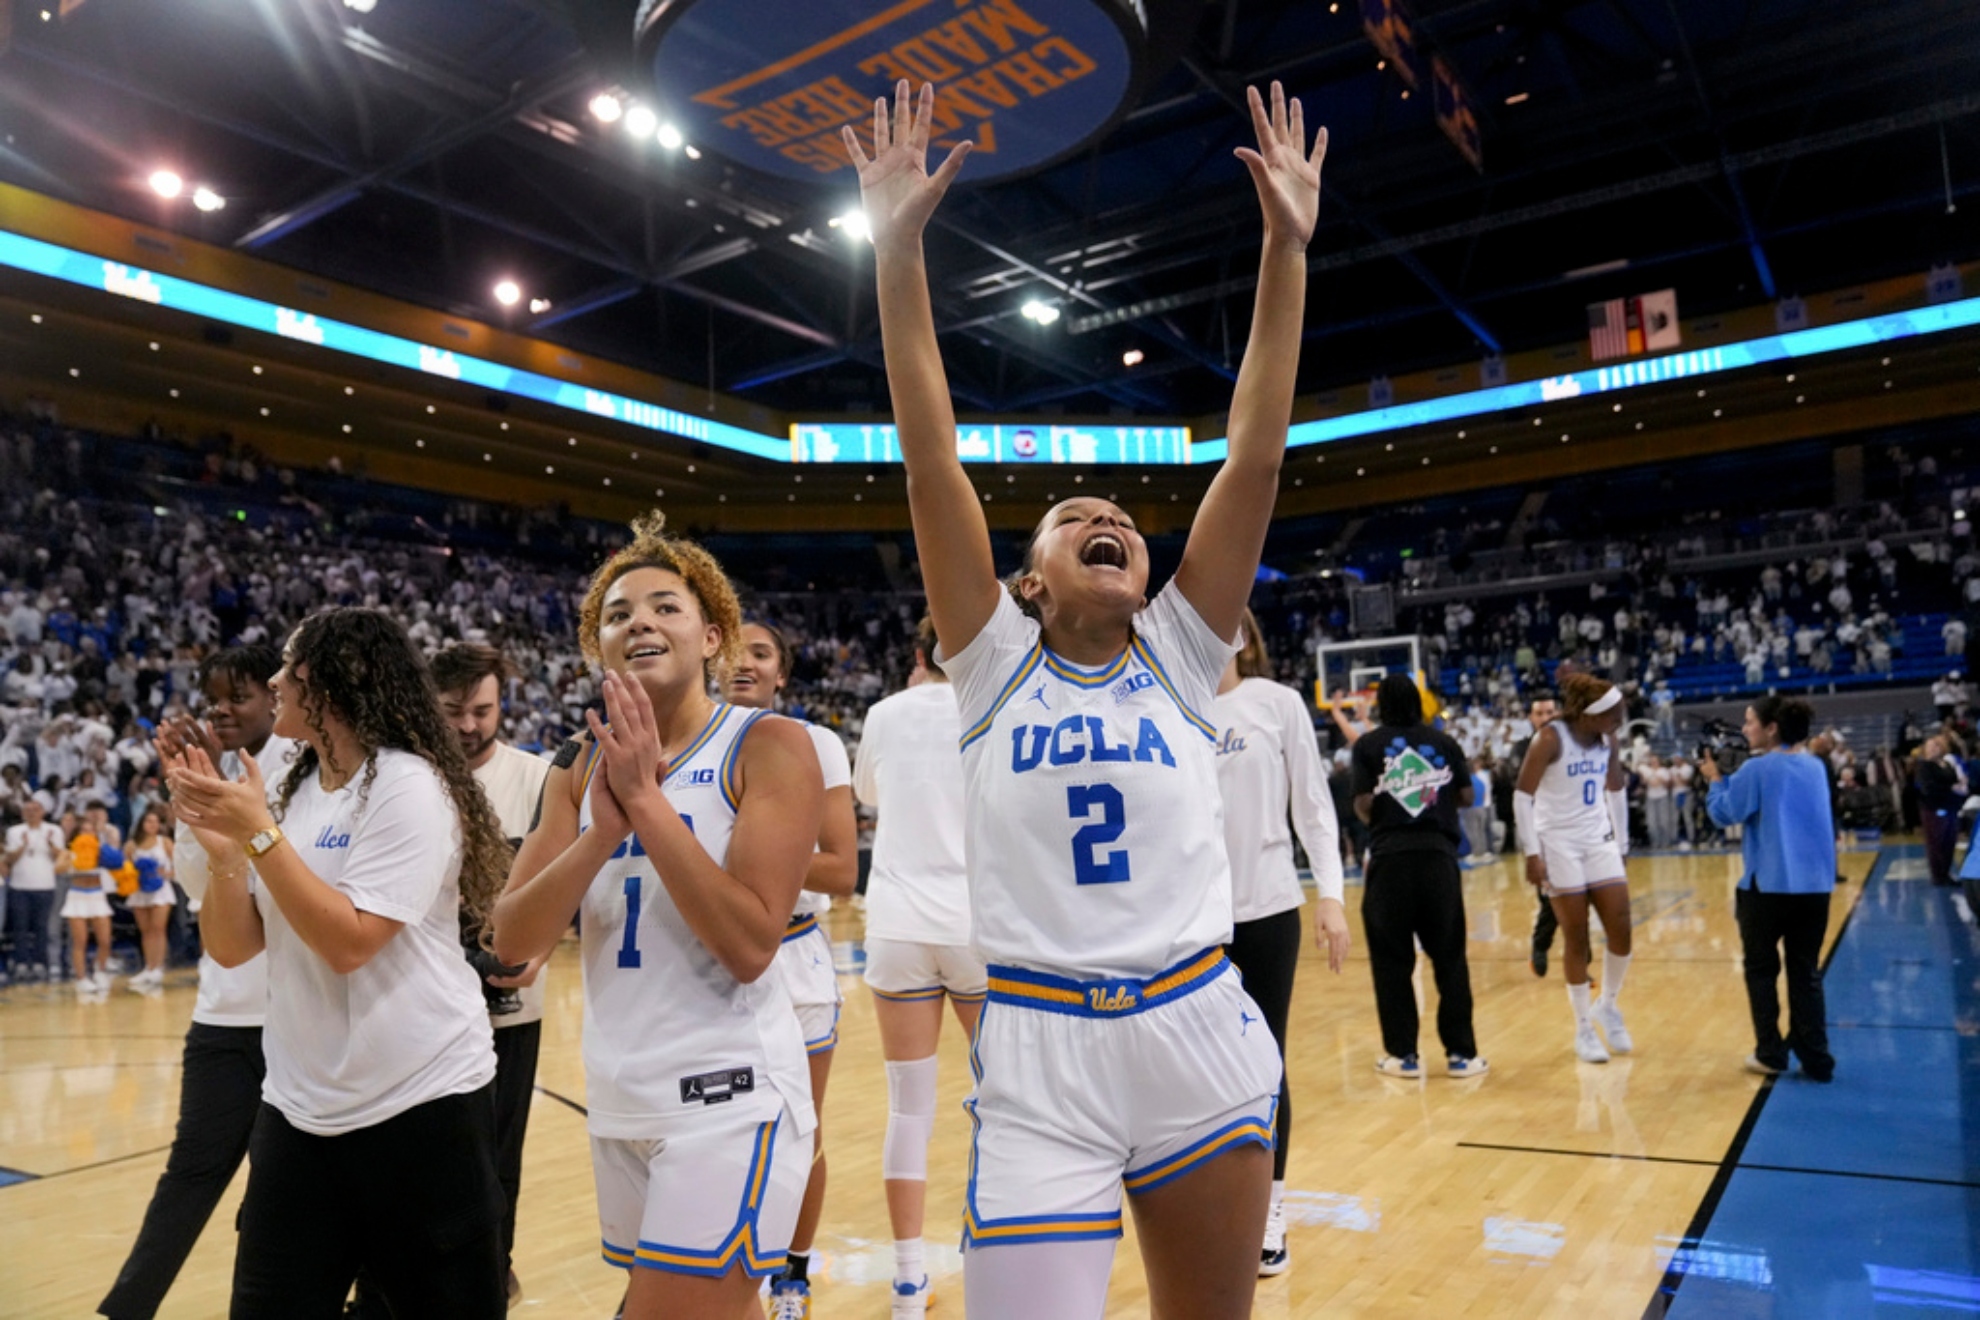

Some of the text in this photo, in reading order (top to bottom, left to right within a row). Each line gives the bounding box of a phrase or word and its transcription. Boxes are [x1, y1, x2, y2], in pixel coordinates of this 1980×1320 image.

[721, 0, 1050, 148] MADE HERE
[780, 36, 1098, 173] CHAMNS
[1011, 714, 1177, 774] UCLA
[1066, 782, 1131, 886] 2
[1583, 779, 1595, 806] 0
[617, 876, 642, 969] 1
[1089, 985, 1137, 1011] Ucla
